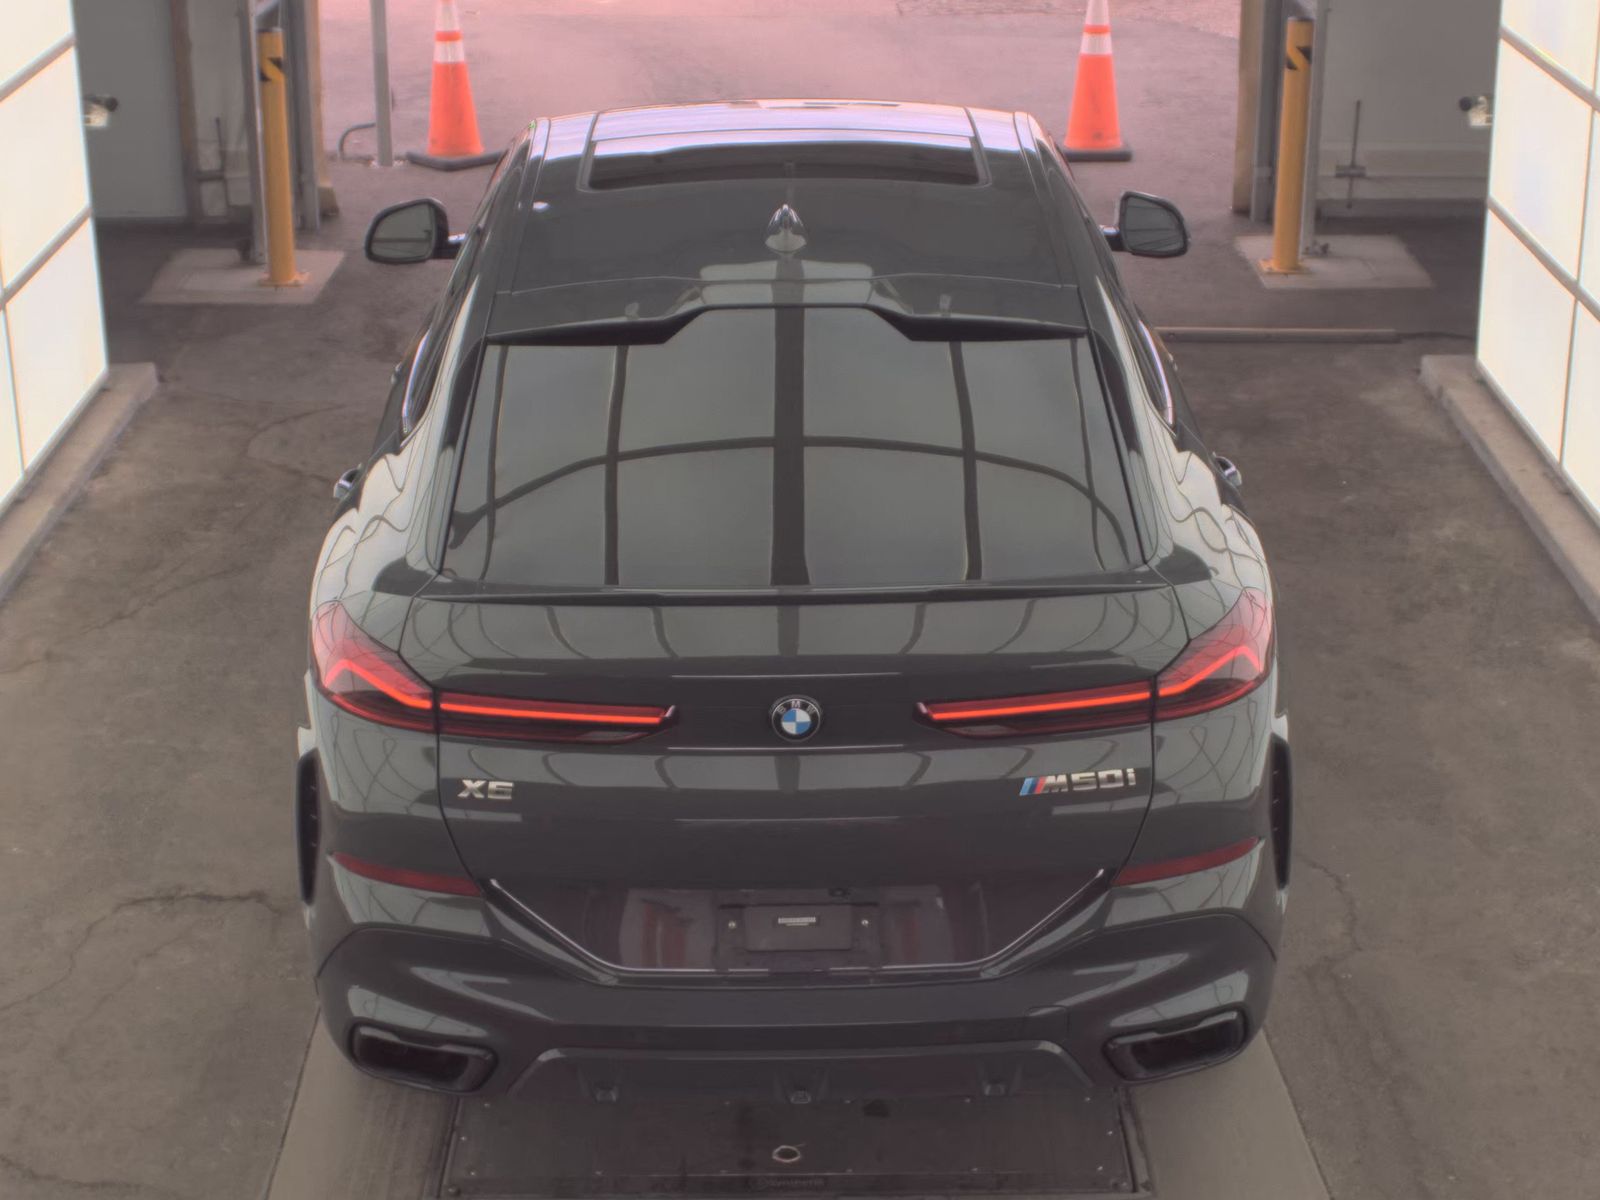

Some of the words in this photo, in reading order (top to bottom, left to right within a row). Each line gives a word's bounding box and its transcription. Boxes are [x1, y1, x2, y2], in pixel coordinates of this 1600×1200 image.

[776, 700, 817, 714] BMW
[457, 779, 514, 800] X6
[1040, 767, 1137, 793] M50i
